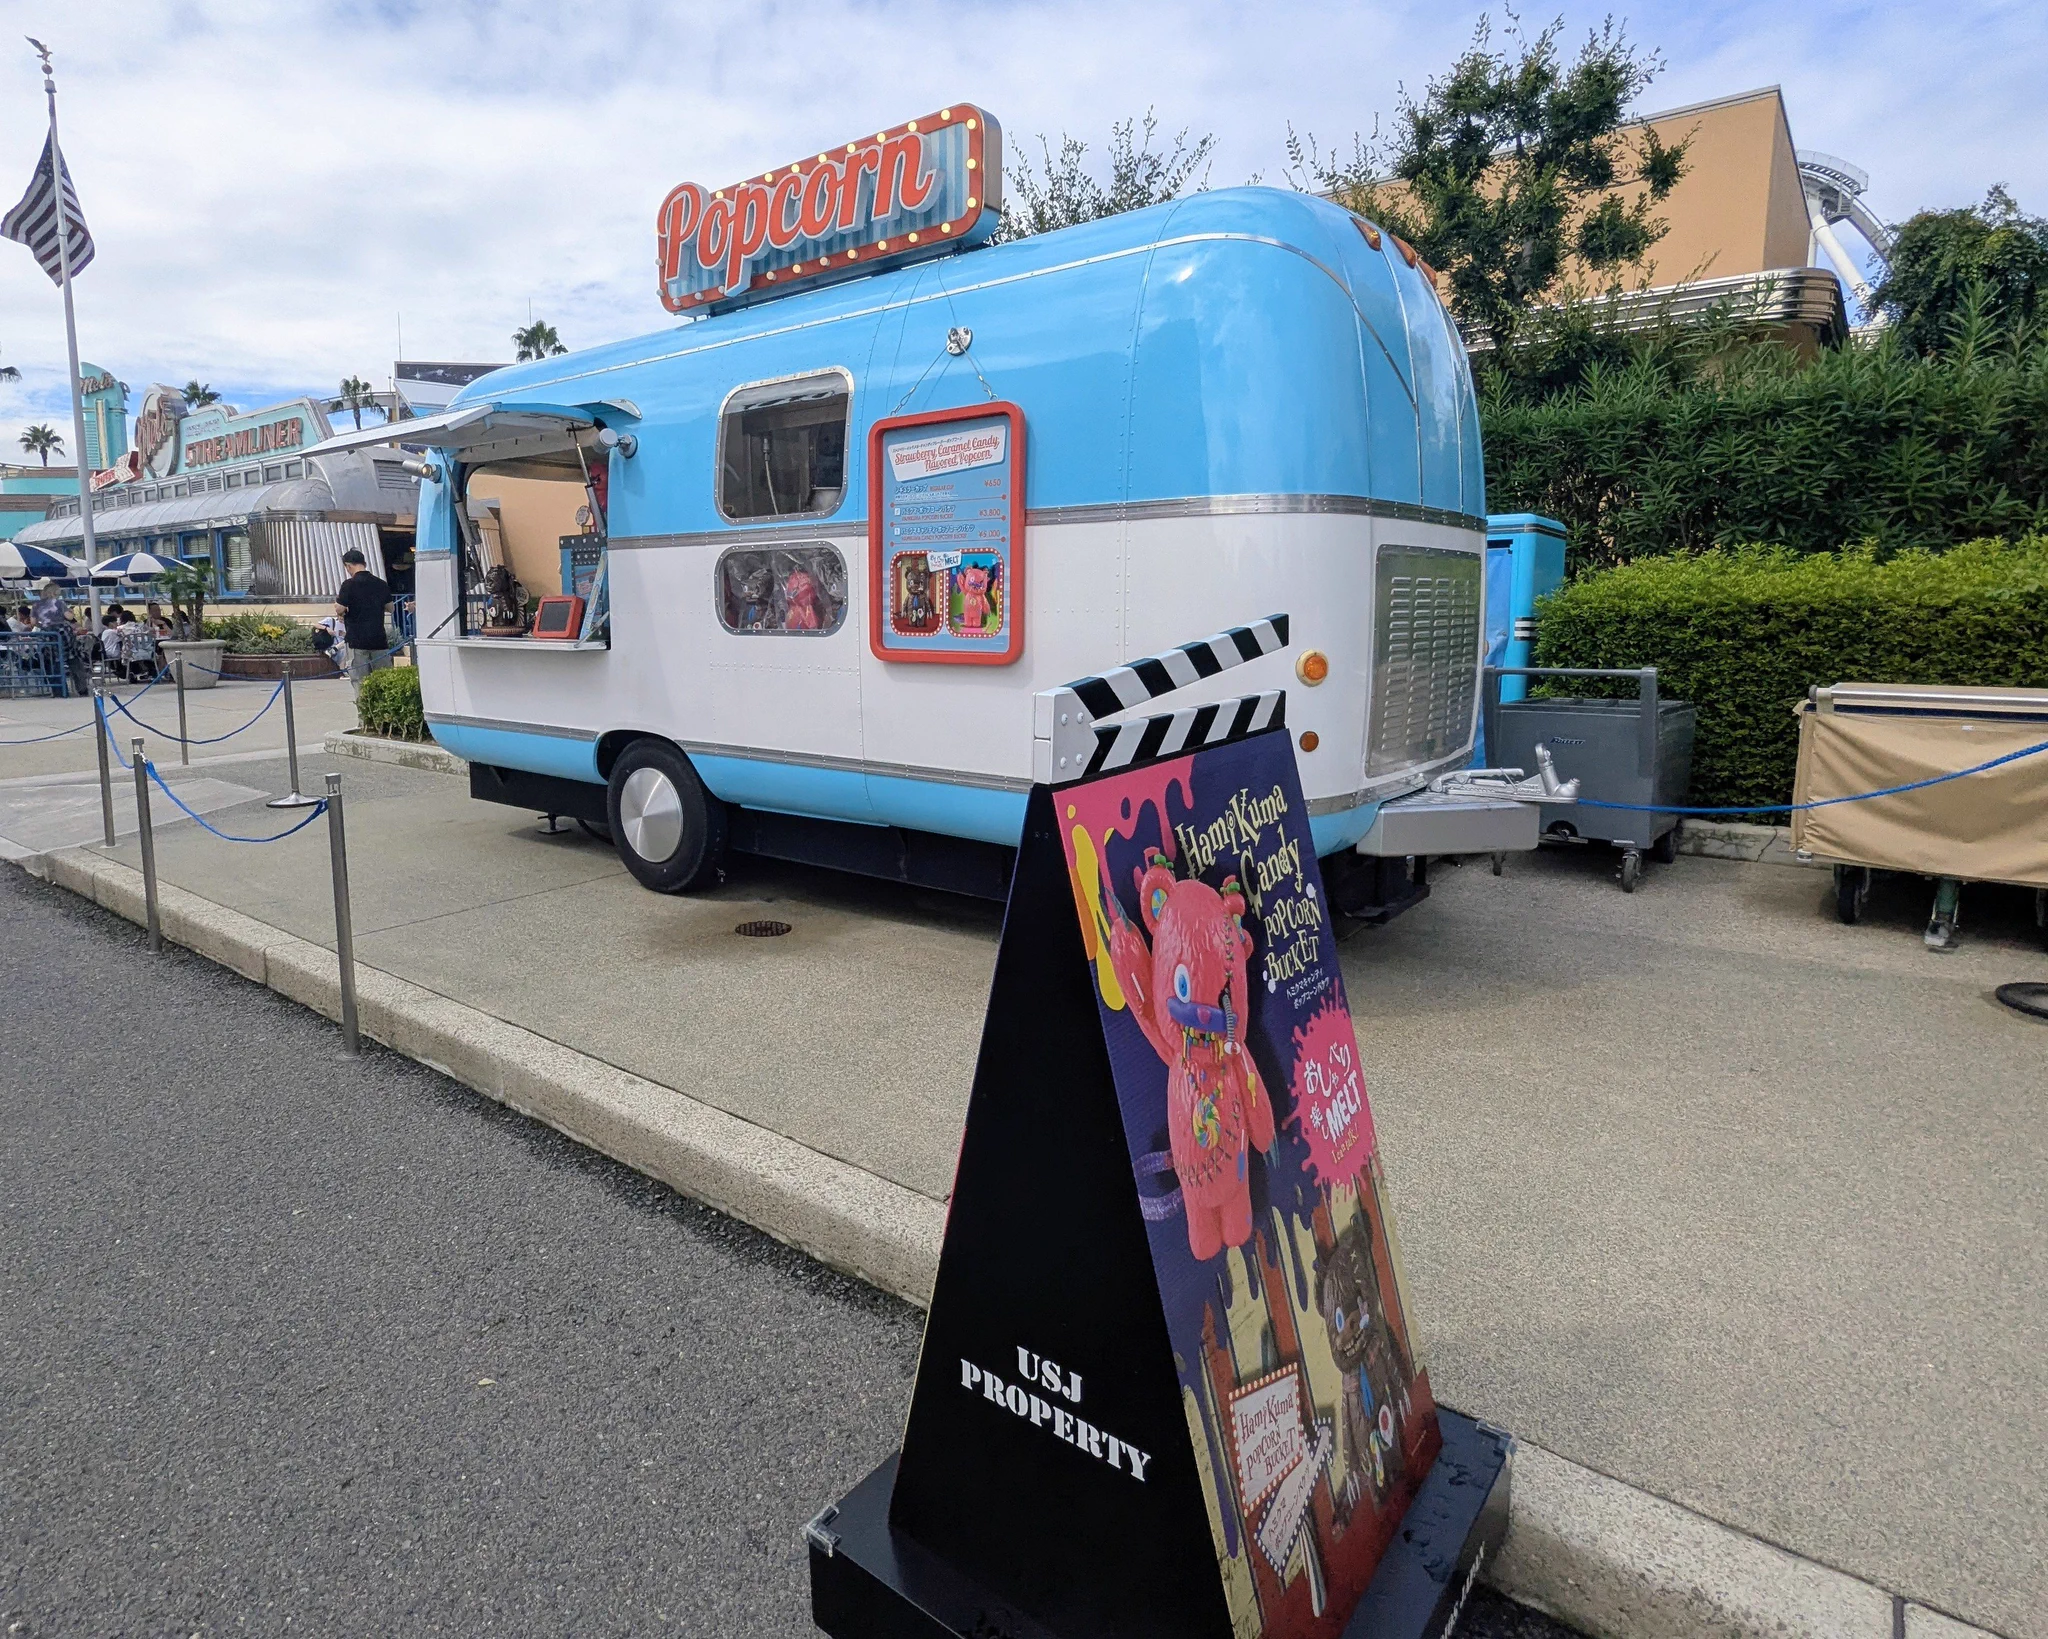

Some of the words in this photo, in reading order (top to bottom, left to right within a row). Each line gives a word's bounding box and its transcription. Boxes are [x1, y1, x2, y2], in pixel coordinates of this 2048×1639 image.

[656, 131, 940, 297] Popcorn
[185, 417, 303, 468] STREAMLINER
[895, 449, 937, 466] Strawberry
[938, 440, 972, 457] Caramel
[972, 435, 1000, 450] Candy
[925, 455, 958, 472] Flavored
[959, 449, 993, 466] Popcorn
[984, 479, 1001, 487] ¥650
[1240, 823, 1304, 920] Candy
[1263, 889, 1323, 948] POPCORN
[1264, 928, 1320, 982] BUCKET
[1286, 967, 1323, 1000] ハミクマキャンディ
[1293, 976, 1330, 1010] ポップコーンバケツ
[1325, 1069, 1362, 1148] MELT
[1016, 1345, 1083, 1404] USJ
[960, 1358, 1151, 1482] PROPERTY
